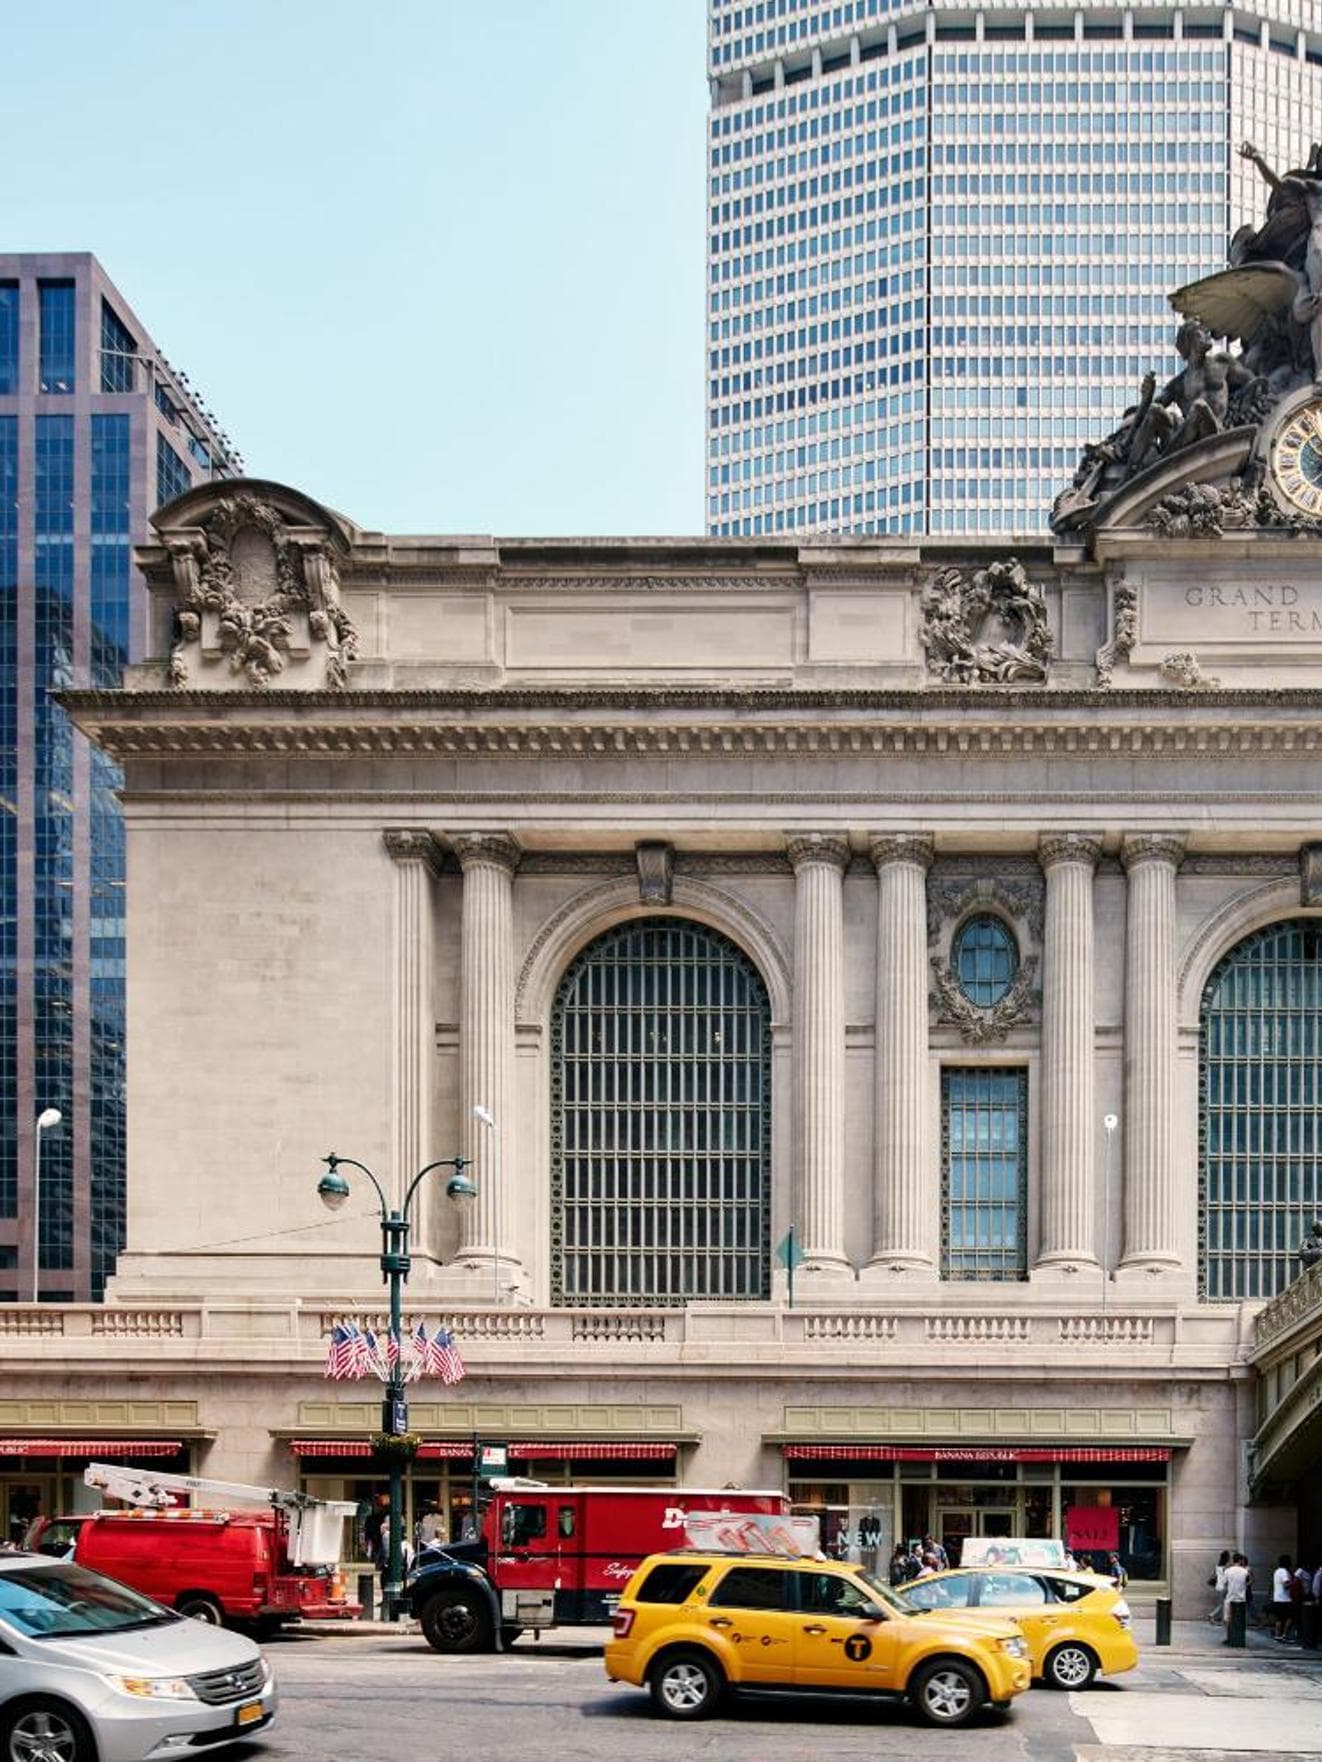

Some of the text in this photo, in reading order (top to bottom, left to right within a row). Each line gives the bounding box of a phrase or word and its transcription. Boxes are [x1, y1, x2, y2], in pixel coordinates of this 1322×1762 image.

[1184, 585, 1300, 607] GRAND
[934, 1451, 973, 1460] BANANA
[836, 1530, 882, 1546] NEW
